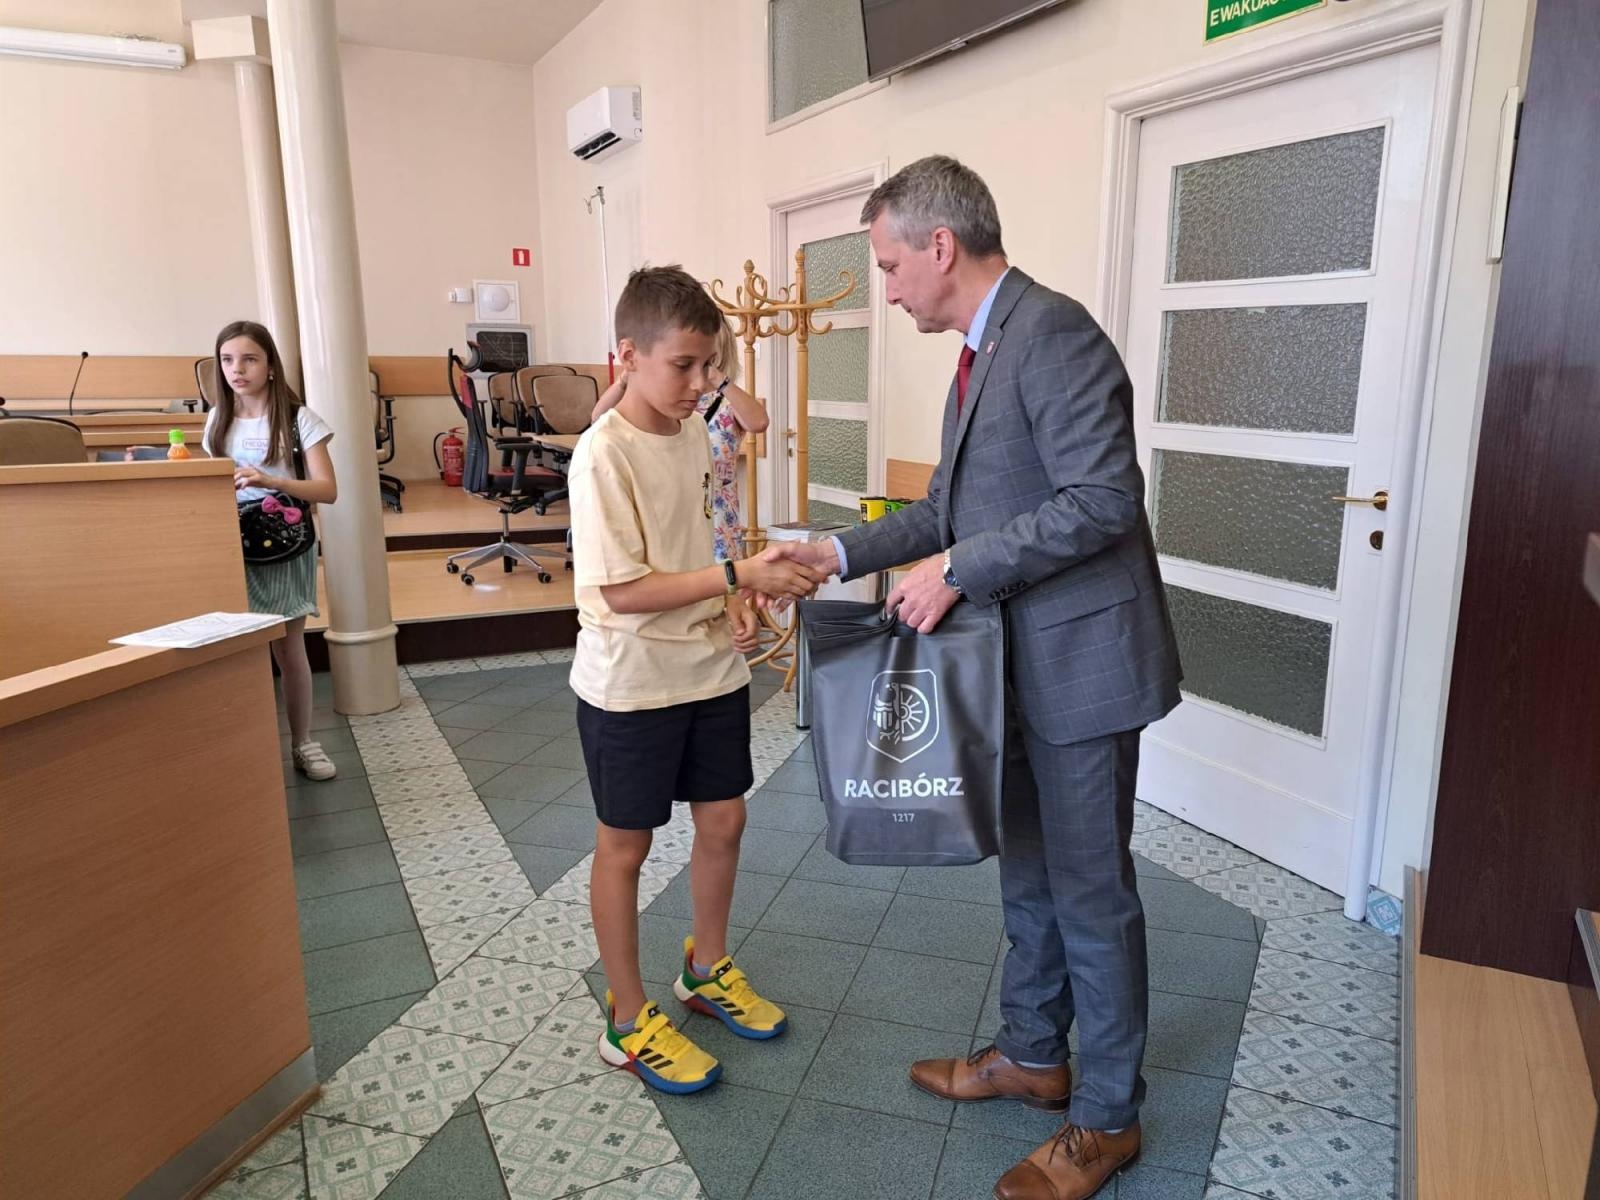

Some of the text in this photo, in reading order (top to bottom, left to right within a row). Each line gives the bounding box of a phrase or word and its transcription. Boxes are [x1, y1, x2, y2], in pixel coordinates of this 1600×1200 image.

[1210, 0, 1286, 27] EWAKUA
[844, 772, 964, 798] RACIBÓRZ
[892, 812, 915, 822] 1217
